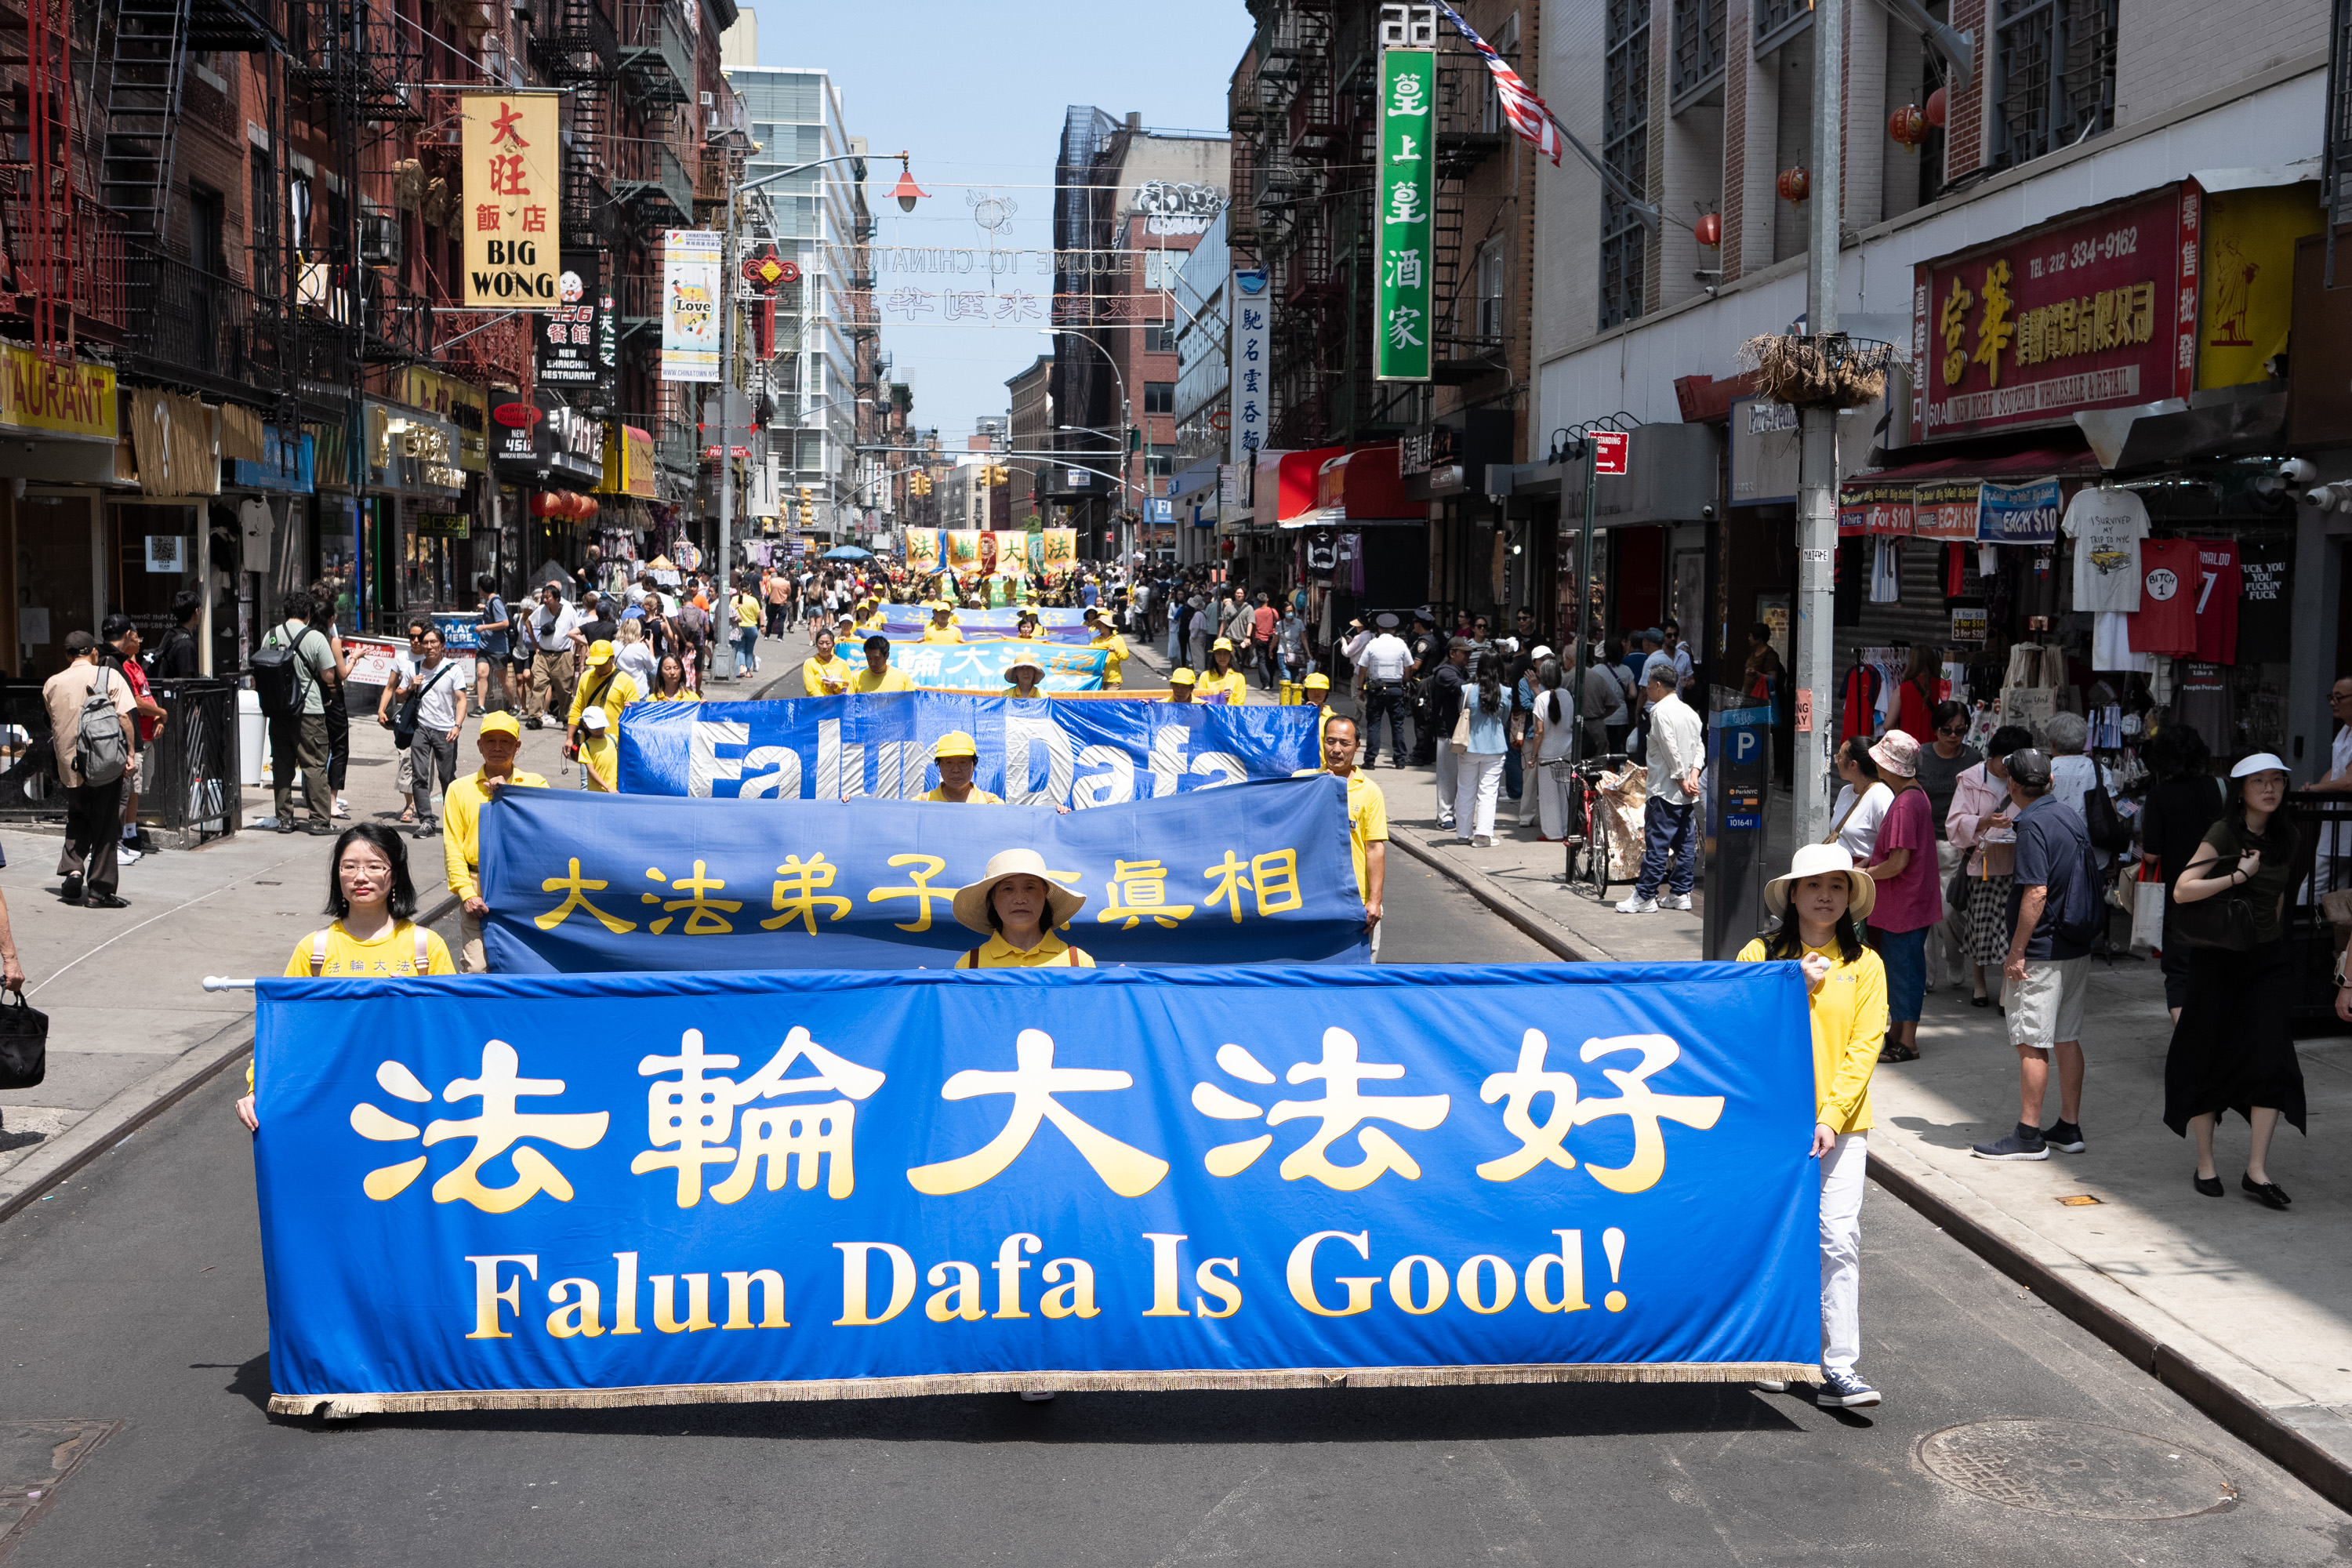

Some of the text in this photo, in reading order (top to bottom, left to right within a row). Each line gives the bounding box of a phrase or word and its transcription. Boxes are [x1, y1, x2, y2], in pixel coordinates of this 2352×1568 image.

[490, 102, 531, 196] 大旺
[477, 205, 546, 232] 飯店
[488, 240, 536, 266] BIG
[2031, 226, 2137, 278] TEL: (212) 334-9162
[471, 272, 554, 298] WONG
[2179, 194, 2198, 369] 零售批發
[677, 299, 711, 312] Love
[543, 305, 594, 323] 456
[547, 324, 592, 345] 餐館
[559, 349, 576, 358] NEW
[1912, 285, 1926, 423] 直接進口
[546, 360, 590, 369] SHANGHAI
[541, 370, 597, 381] RESTAURANT
[1929, 368, 2129, 426] 60A NEW YORK SOUVENIR WHOLESALE & RETAIL
[511, 429, 526, 438] NEW
[1597, 436, 1621, 445] STANDING
[1871, 506, 1889, 527] For
[1892, 506, 1911, 530] $10
[1938, 506, 1962, 529] ECH
[2003, 510, 2032, 533] EACH
[2034, 507, 2056, 535] $10
[2096, 516, 2131, 526] SURVIVED
[2103, 526, 2113, 535] MY
[2089, 535, 2105, 544] TRIP
[2116, 535, 2130, 544] NYC
[912, 536, 1070, 562] 法 輪 大 法
[2199, 551, 2230, 566] ONALDO
[2240, 562, 2285, 573] FUCK YOU
[2148, 573, 2176, 586] BITCH
[2252, 572, 2272, 583] YOU
[2158, 584, 2165, 596] 1
[2196, 571, 2218, 614] 7
[2245, 581, 2281, 591] FUCKIN'
[2249, 590, 2278, 601] FUCK
[904, 611, 1068, 627] 法大好
[1972, 619, 1984, 628] $14
[445, 624, 471, 633] PLAY
[1972, 630, 1984, 638] $20
[445, 633, 477, 643] HERE.
[2034, 695, 2049, 705] York
[1737, 732, 1755, 759] P
[1005, 715, 1249, 808] Dafa
[533, 848, 1305, 936] 大法弟子眞相
[328, 959, 411, 975] 法輪大法
[350, 1025, 1726, 1214] 法輪大法好
[465, 1225, 1628, 1341] Falun Dafa Is Good!
